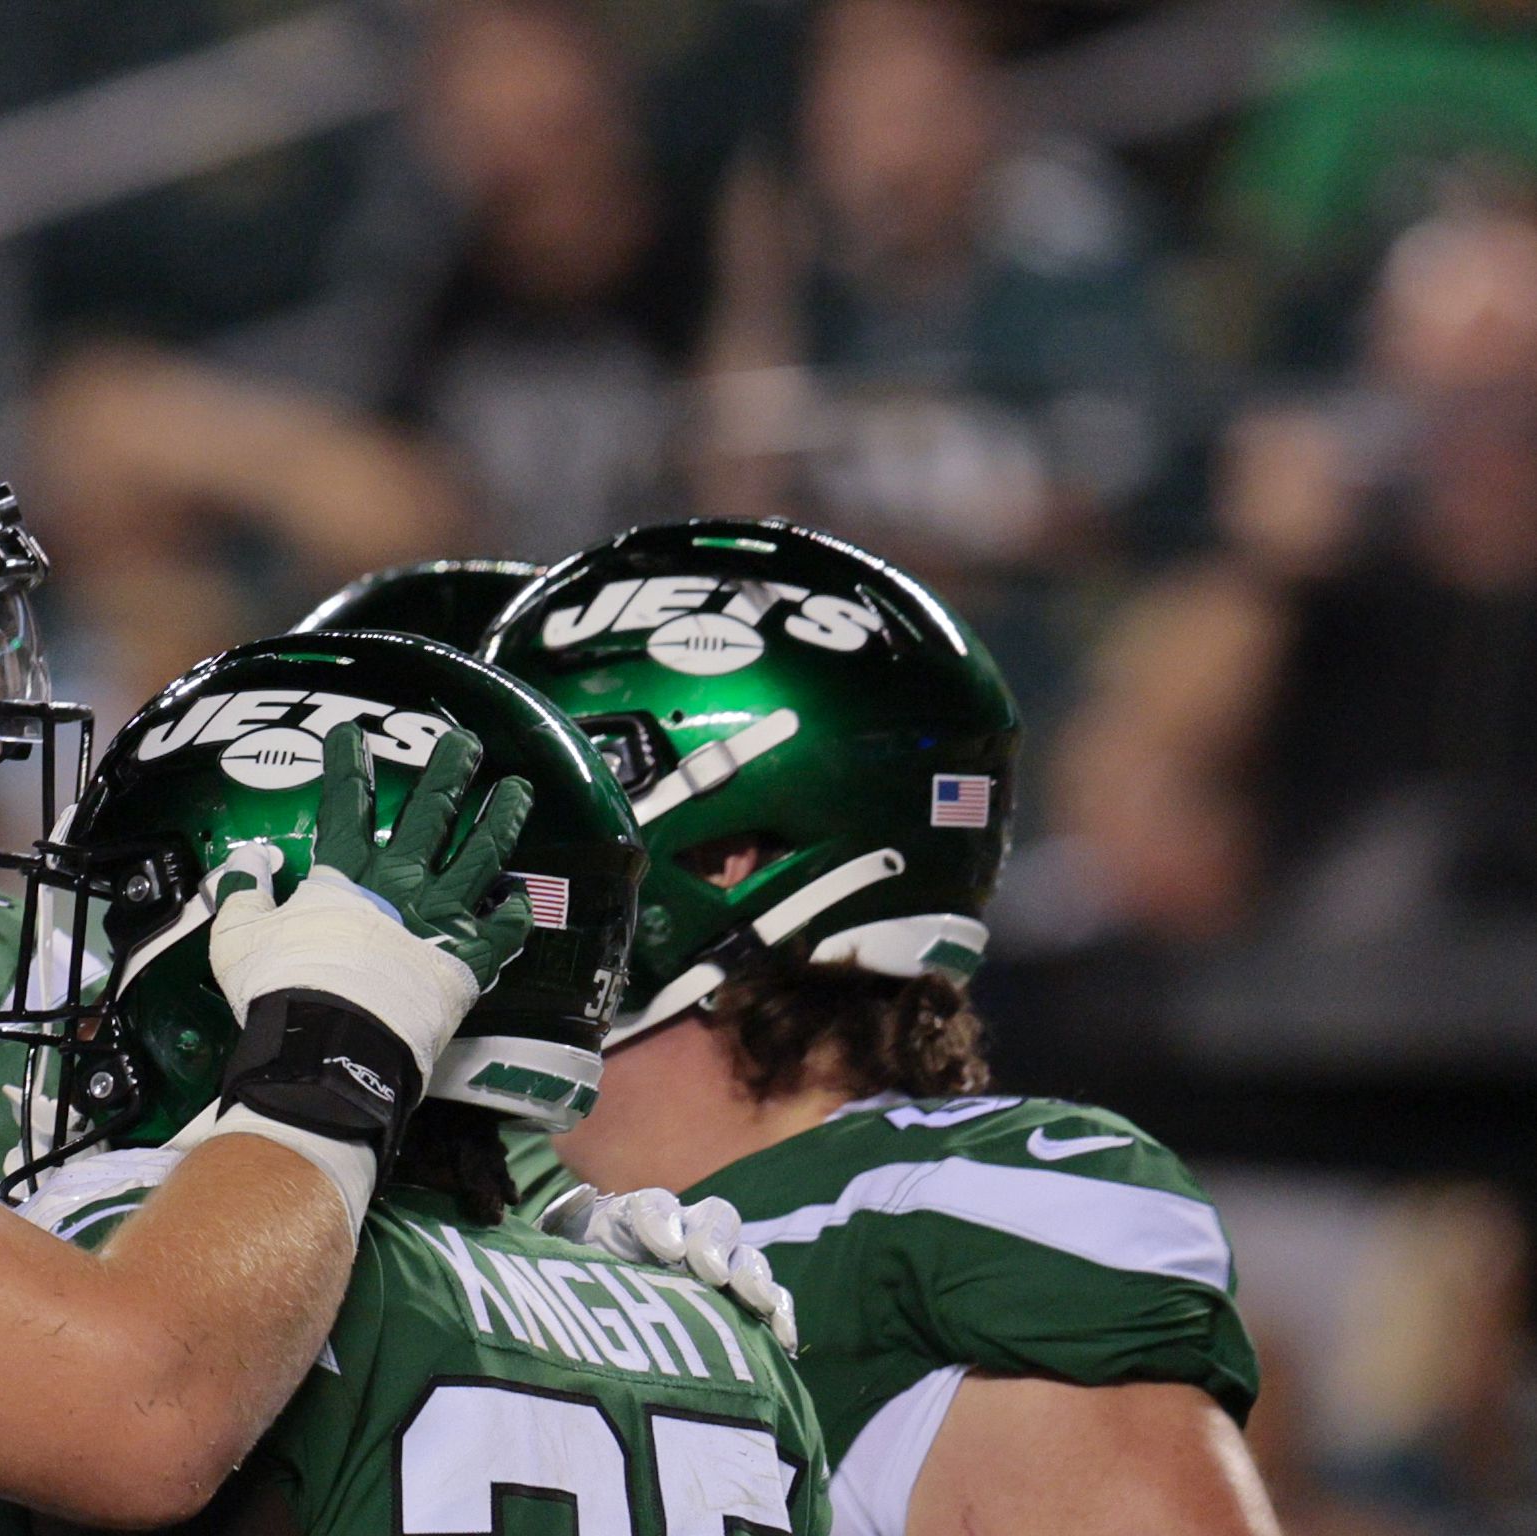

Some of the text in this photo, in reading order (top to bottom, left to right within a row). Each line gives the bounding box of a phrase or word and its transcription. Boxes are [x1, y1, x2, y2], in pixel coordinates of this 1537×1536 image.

[541, 575, 884, 652] JETS
[137, 690, 453, 768] JETS
[406, 1220, 755, 1383] KNIGHT
